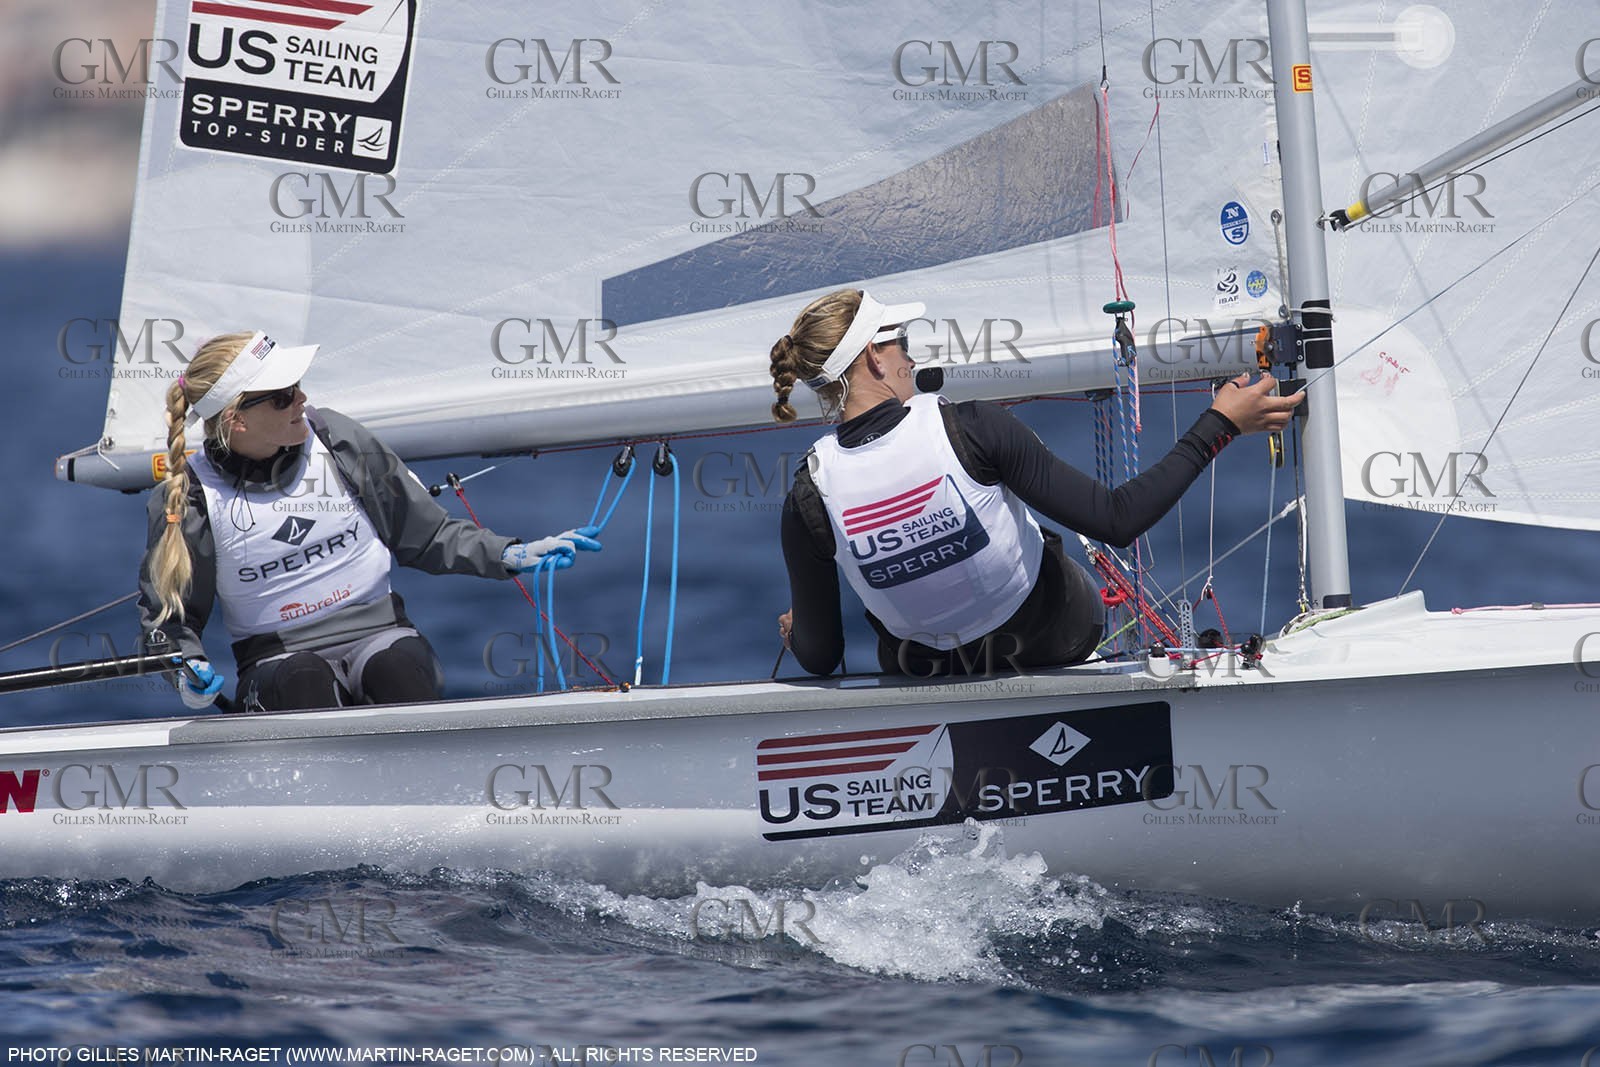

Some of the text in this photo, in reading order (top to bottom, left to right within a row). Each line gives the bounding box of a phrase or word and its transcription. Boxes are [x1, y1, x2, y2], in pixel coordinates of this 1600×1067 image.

[188, 23, 378, 75] US SAILING
[284, 59, 376, 92] TEAM
[191, 93, 352, 134] SPERRY
[191, 120, 344, 154] TOP-SIDER
[238, 520, 359, 582] SPERRY
[849, 507, 954, 560] US SAILING
[905, 516, 961, 543] TEAM
[869, 536, 968, 583] SPERRY
[759, 774, 932, 824] US SAILING
[847, 793, 933, 817] TEAM
[978, 765, 1150, 812] SPERRY
